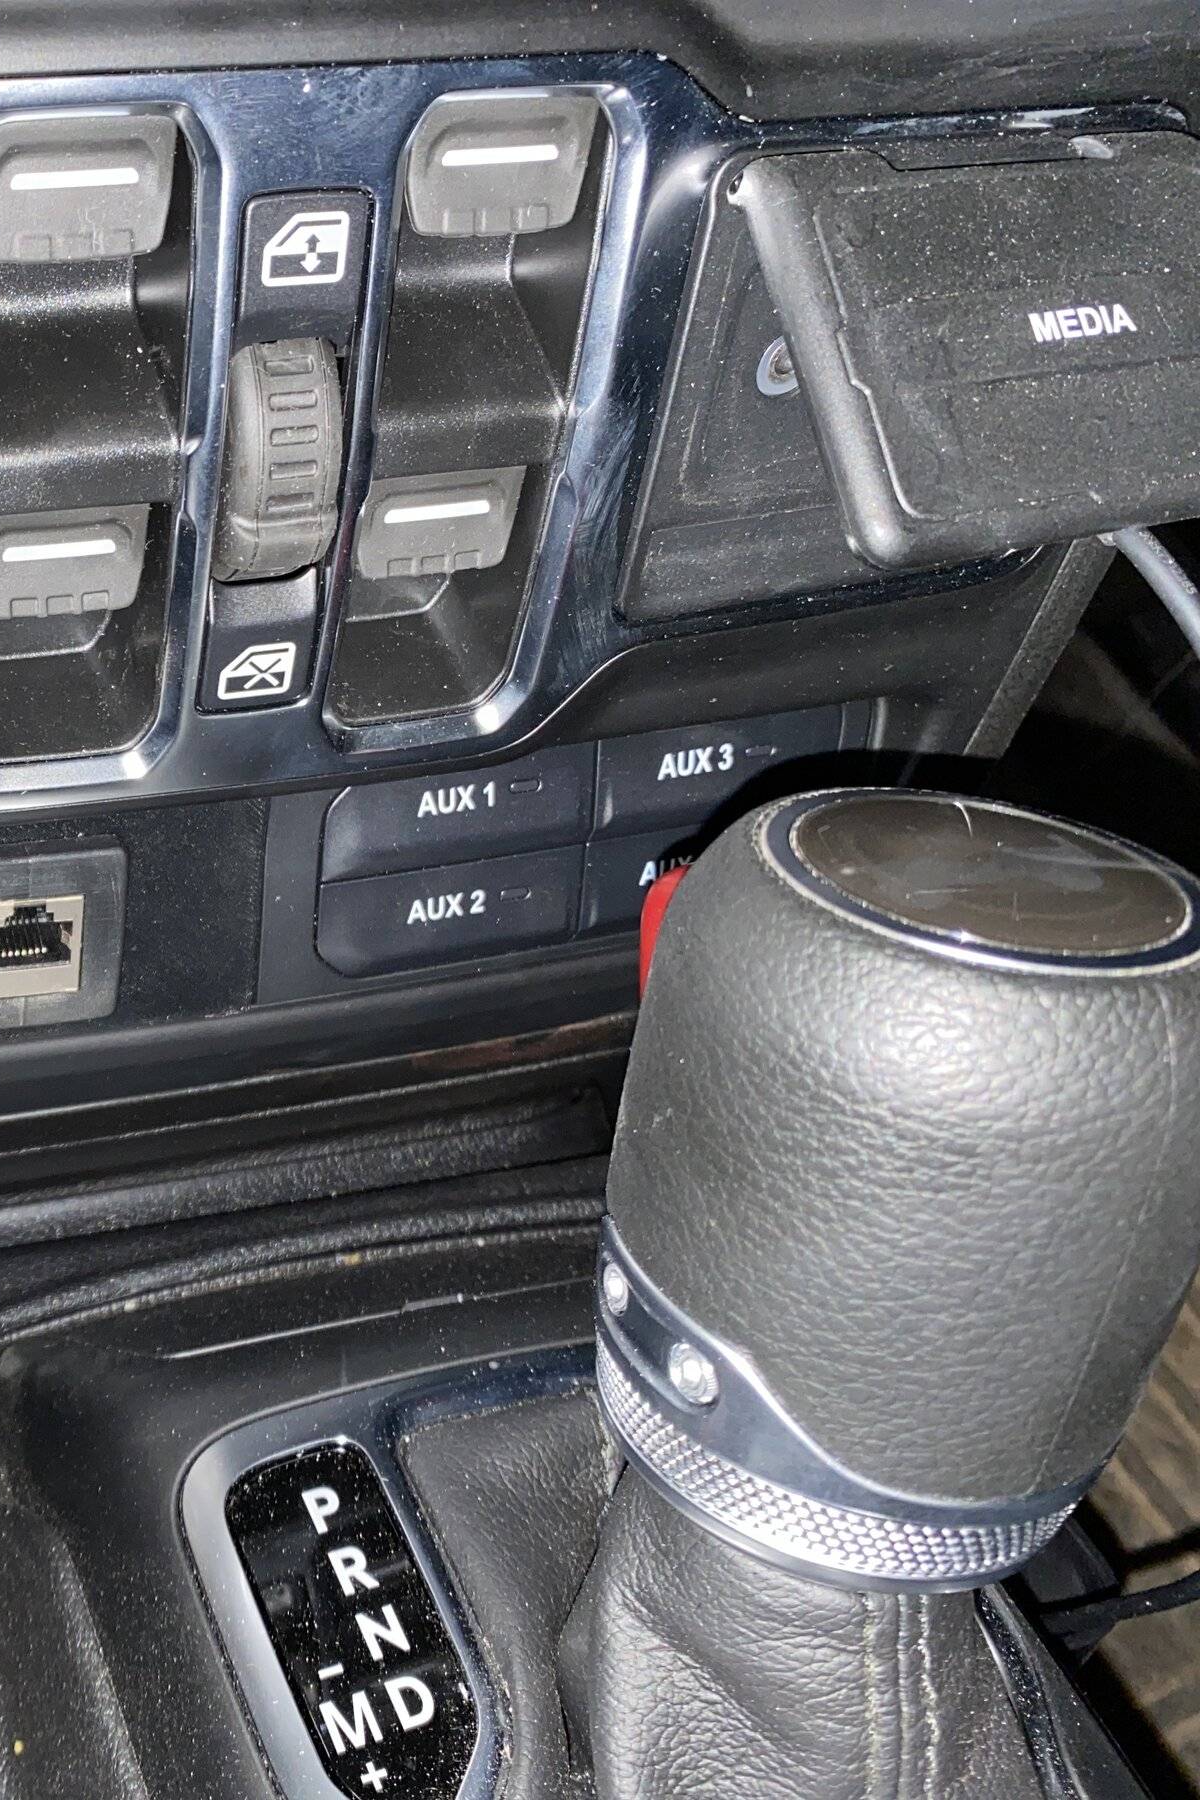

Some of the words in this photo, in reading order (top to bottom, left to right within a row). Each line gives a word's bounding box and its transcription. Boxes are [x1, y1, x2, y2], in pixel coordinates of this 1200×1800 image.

[1029, 303, 1138, 343] MEDIA
[657, 749, 714, 781] AUX
[717, 743, 734, 771] 3
[417, 788, 477, 818] AUX
[482, 781, 497, 808] 1
[407, 896, 464, 925] AUX
[469, 888, 486, 915] 2
[301, 1486, 340, 1535] P
[327, 1545, 380, 1597] R
[355, 1603, 412, 1662] N
[318, 1690, 384, 1756] M
[384, 1676, 435, 1732] D
